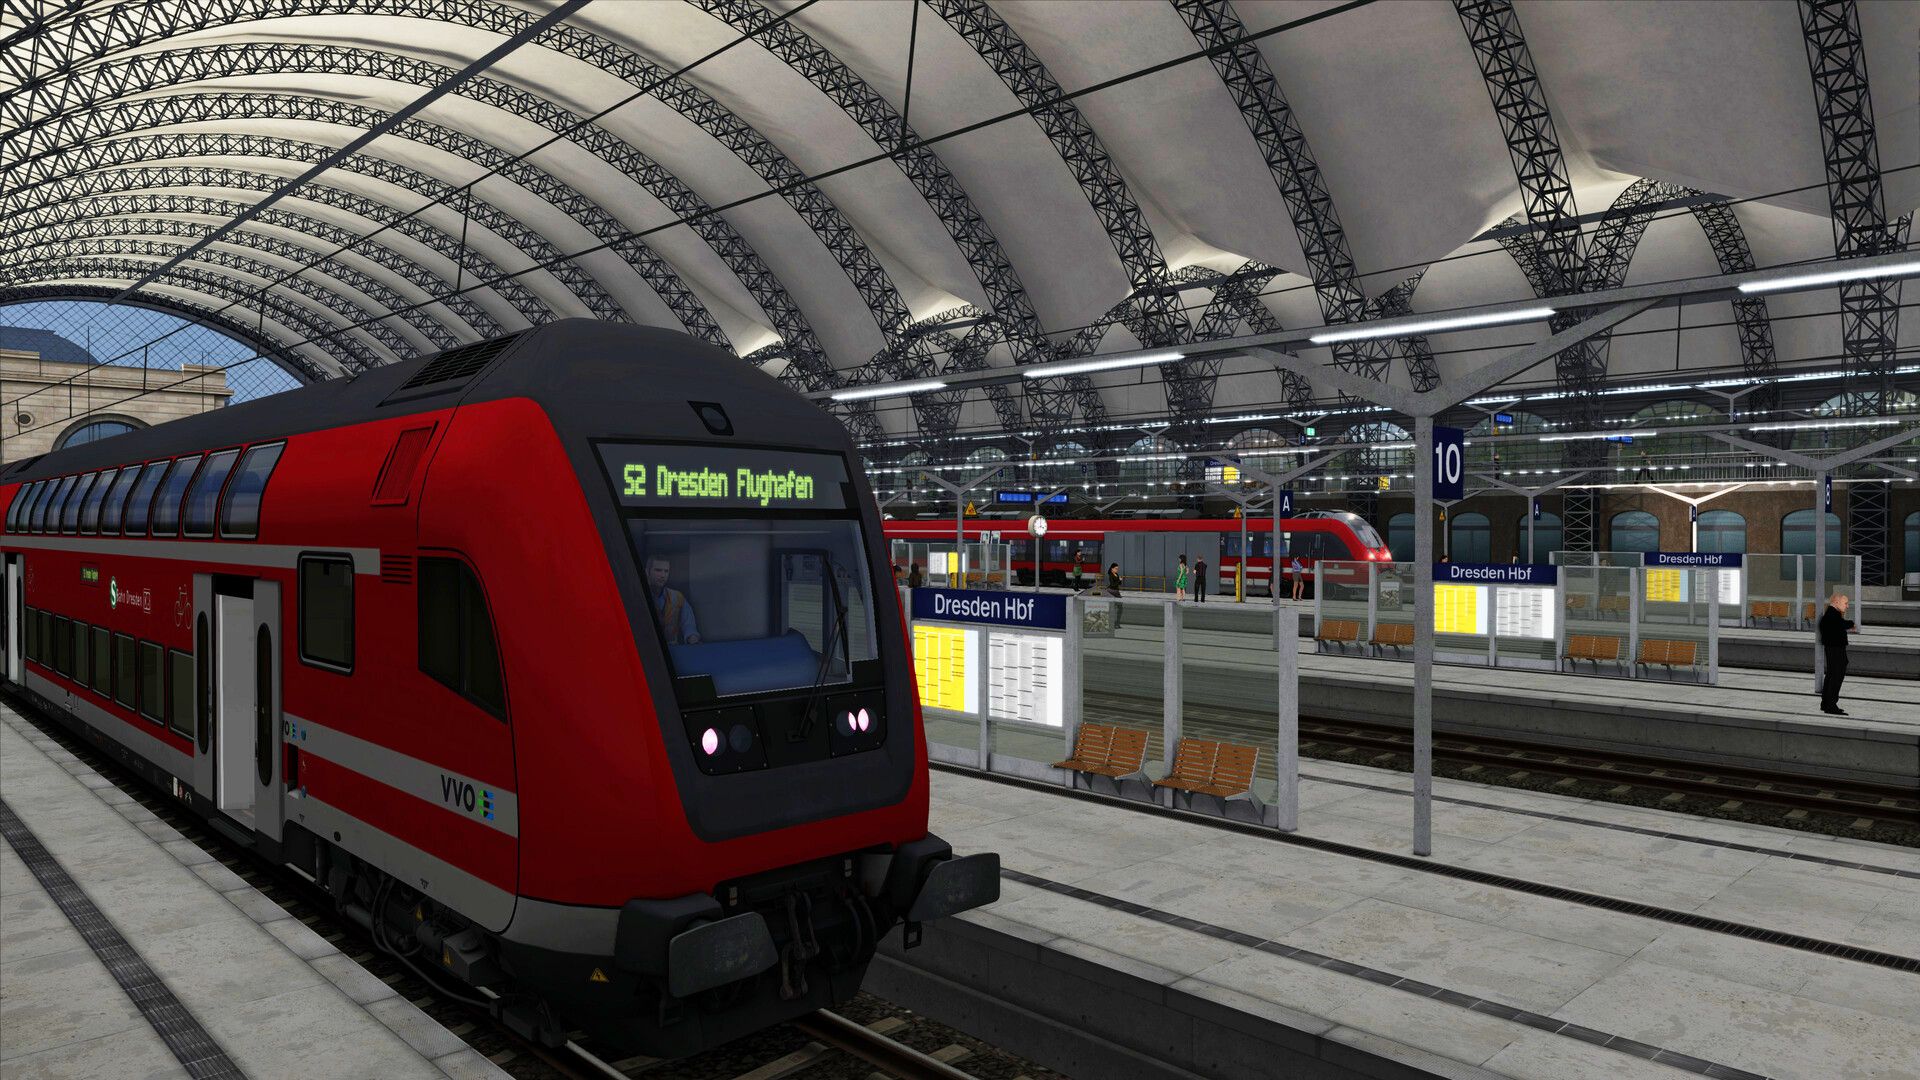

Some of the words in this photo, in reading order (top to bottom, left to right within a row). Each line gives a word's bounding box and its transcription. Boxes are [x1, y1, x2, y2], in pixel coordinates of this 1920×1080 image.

[1435, 442, 1461, 484] 10
[623, 463, 647, 496] S2
[656, 464, 729, 498] Dresden
[736, 468, 814, 507] Flughafen
[1282, 495, 1290, 512] A
[1450, 565, 1505, 579] Dresden
[1508, 567, 1532, 580] Hbf
[1659, 553, 1702, 564] Dresden
[1704, 554, 1723, 564] Hbf
[934, 593, 1000, 618] Dresden
[1005, 597, 1035, 621] Hbf
[440, 774, 476, 812] VVO
